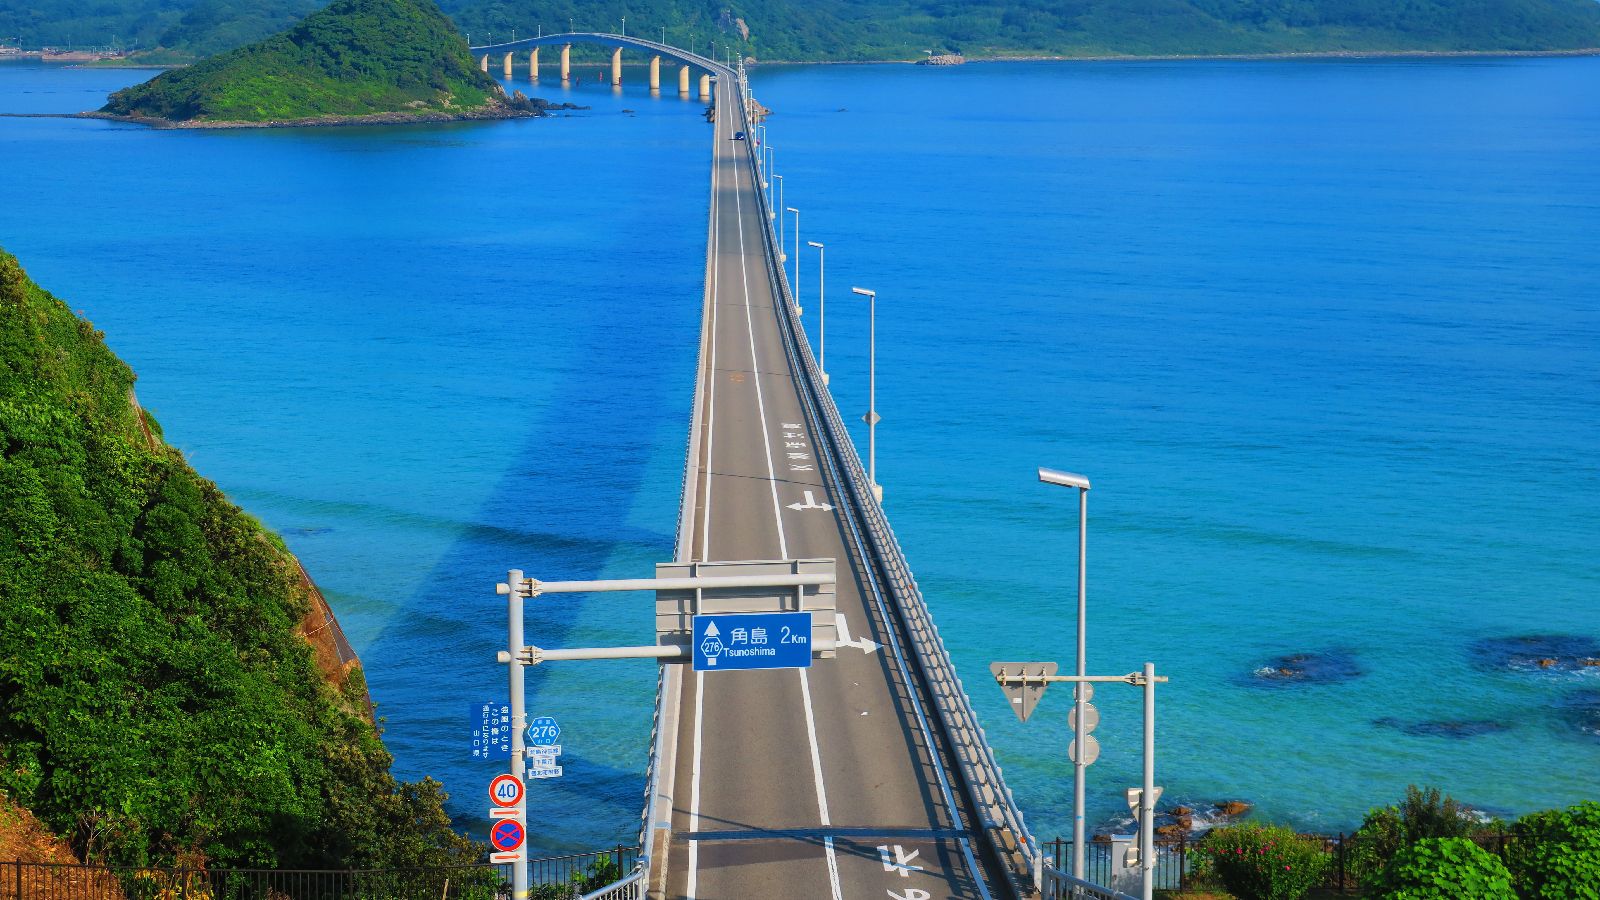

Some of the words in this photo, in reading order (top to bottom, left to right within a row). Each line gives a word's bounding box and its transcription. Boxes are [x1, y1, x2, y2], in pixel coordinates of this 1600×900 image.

[730, 627, 768, 646] 角島
[704, 642, 720, 653] 276
[723, 647, 776, 657] Tsunoshima
[532, 725, 556, 738] 276
[497, 783, 516, 798] 40
